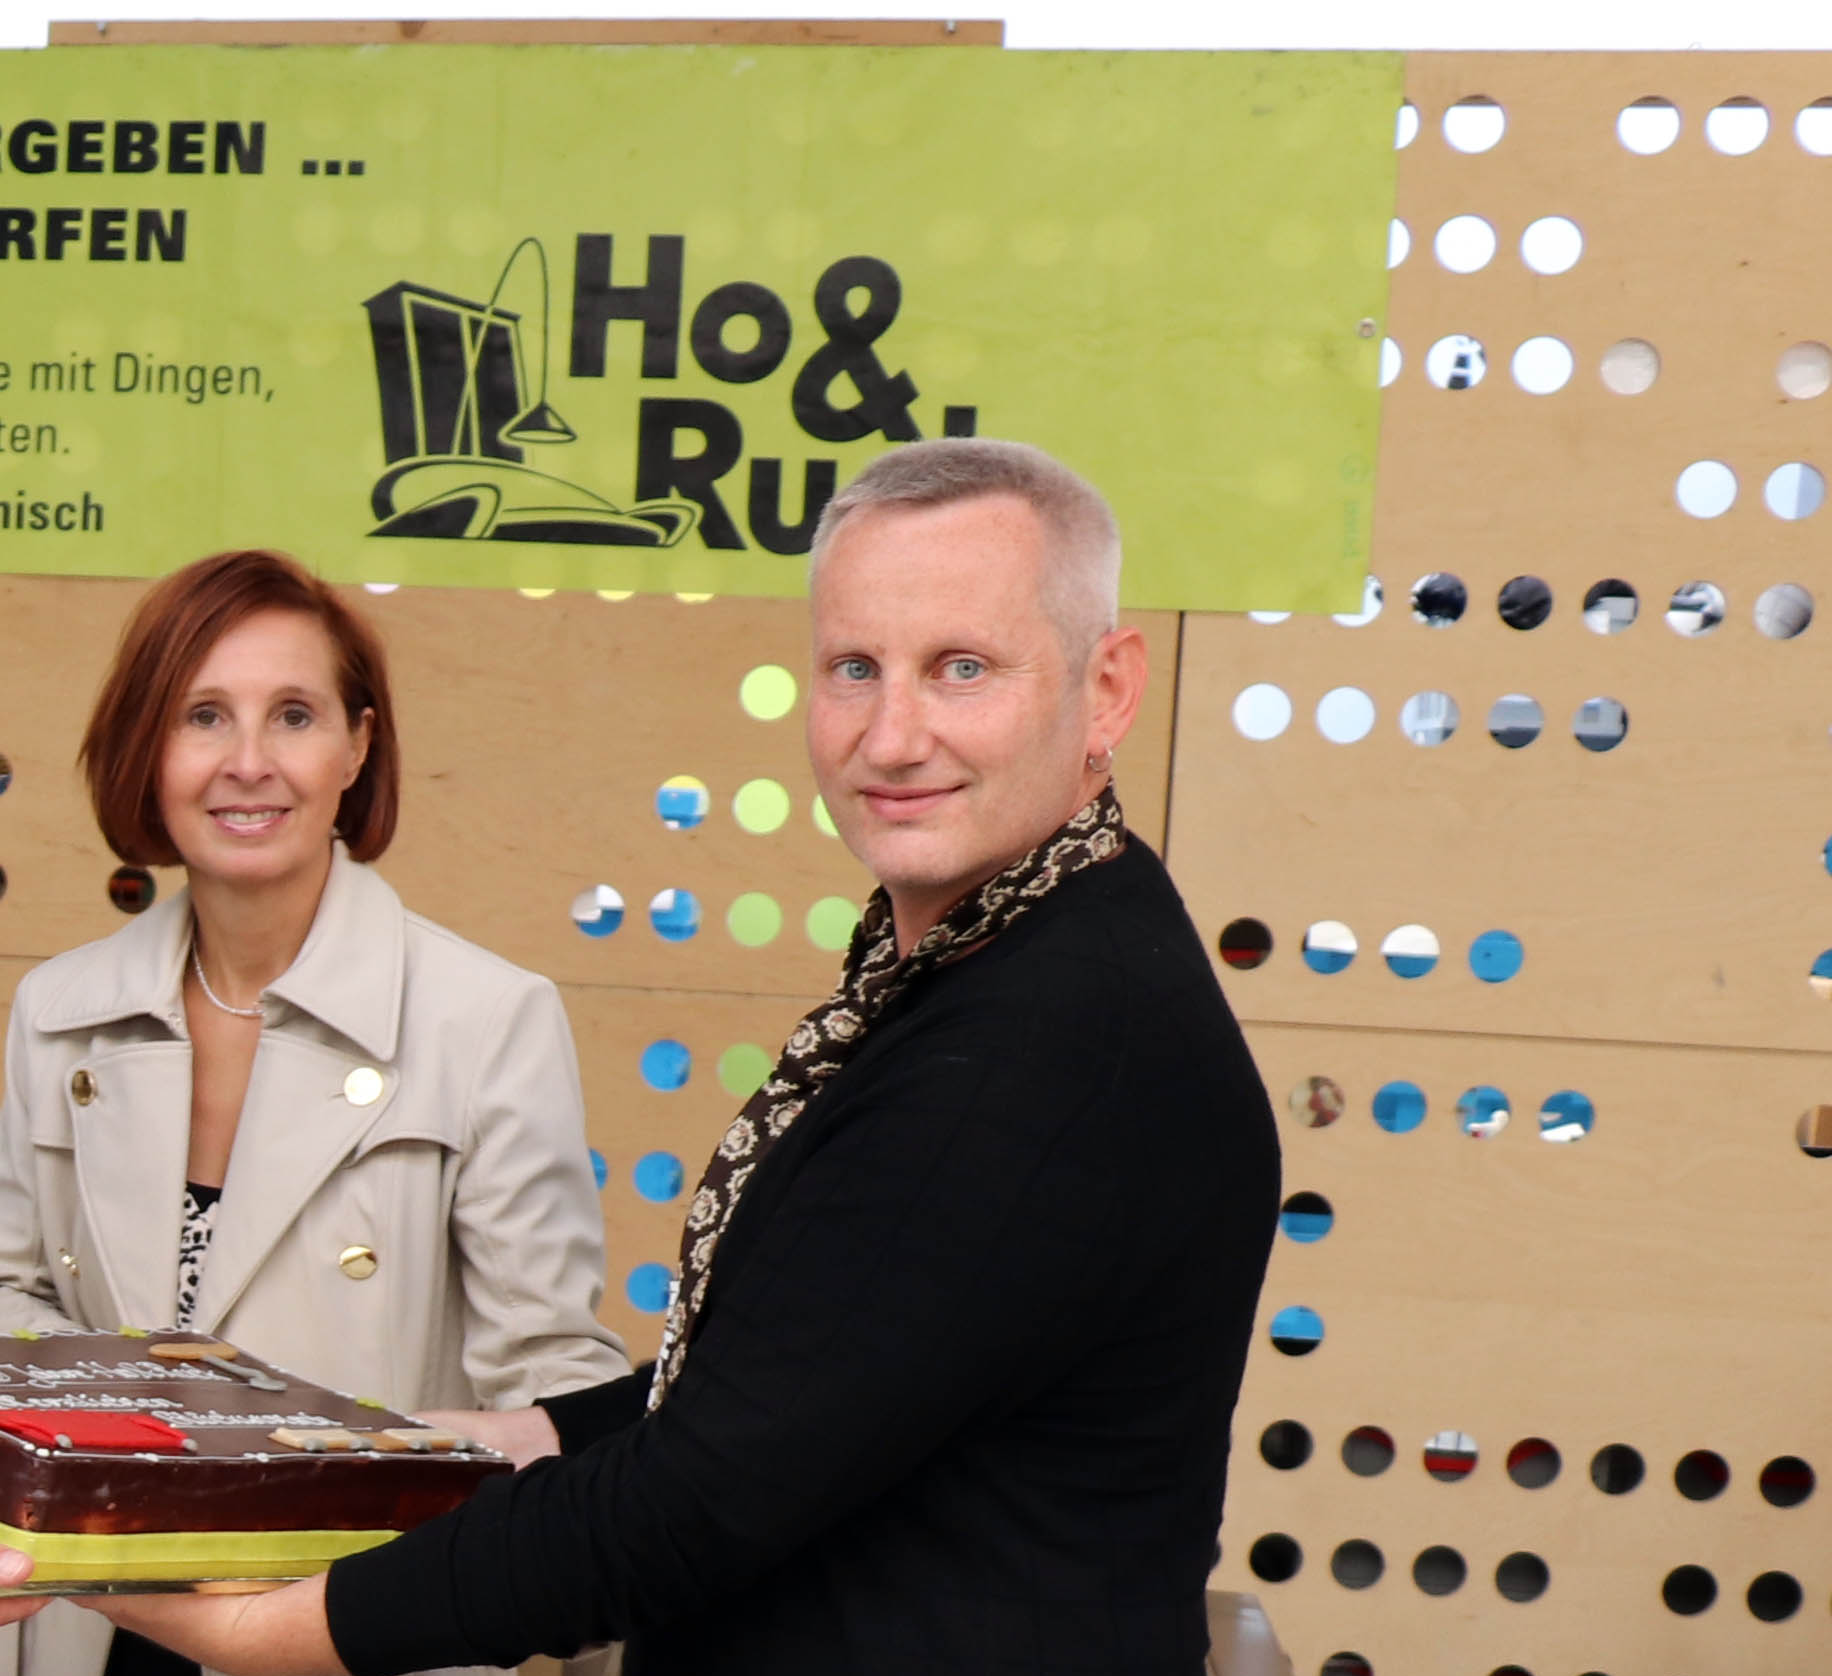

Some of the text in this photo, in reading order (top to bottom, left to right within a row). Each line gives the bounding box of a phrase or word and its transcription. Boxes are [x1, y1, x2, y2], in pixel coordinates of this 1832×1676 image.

[300, 160, 366, 177] ...
[569, 233, 923, 443] Ho&
[29, 352, 97, 393] mit
[112, 352, 275, 404] Dingen,
